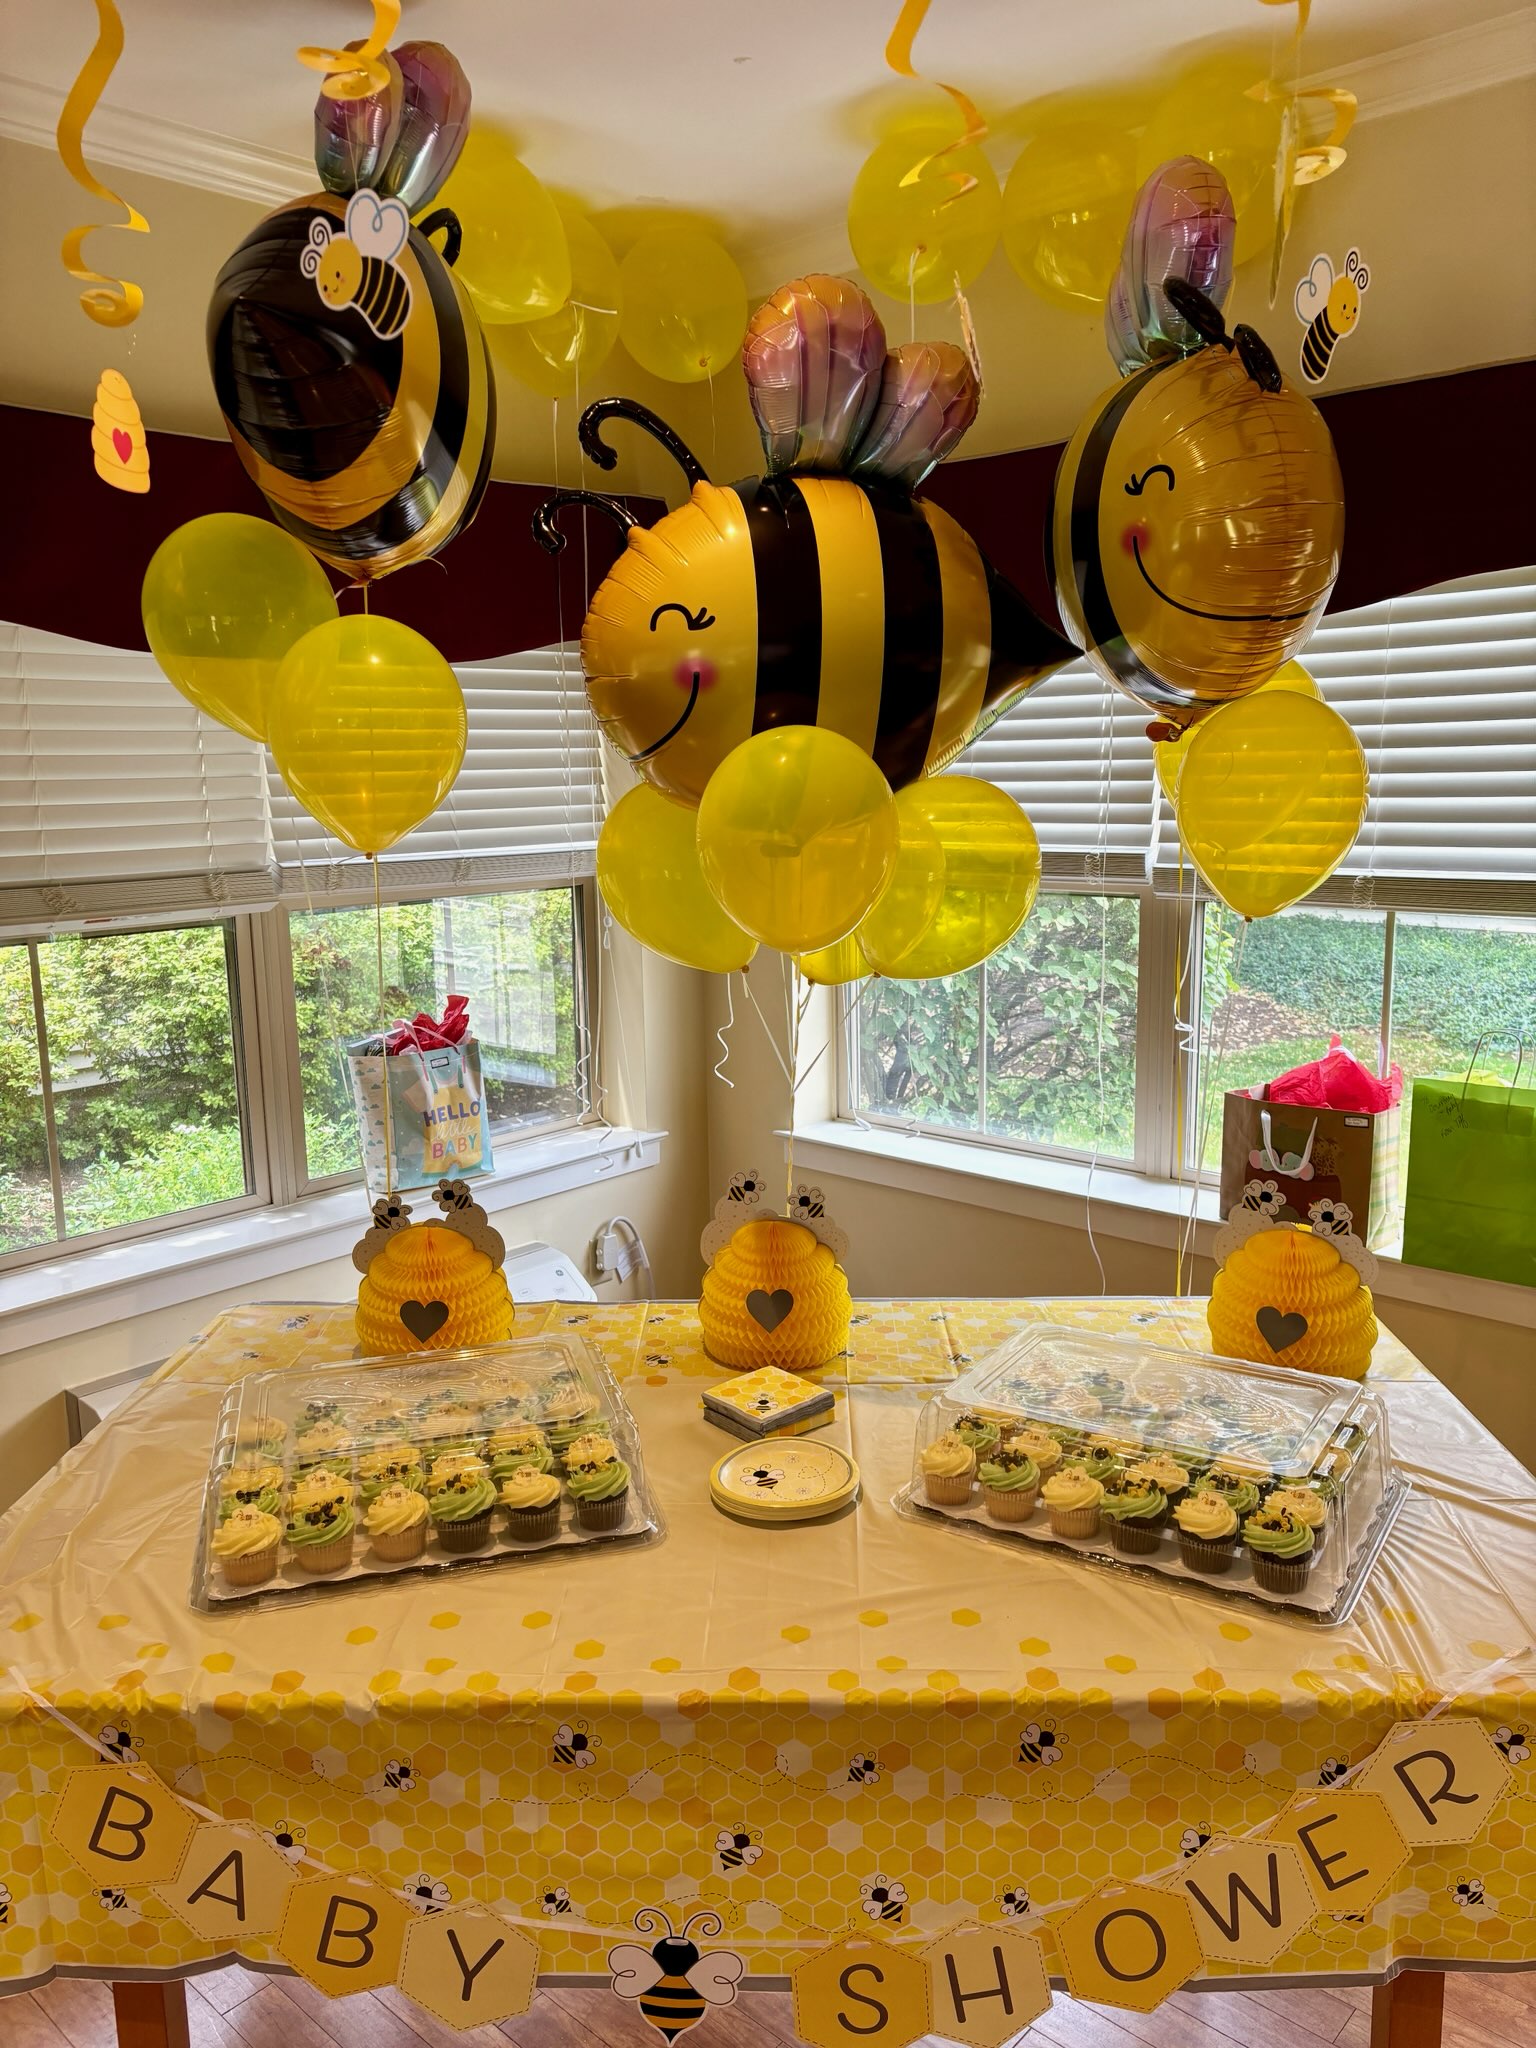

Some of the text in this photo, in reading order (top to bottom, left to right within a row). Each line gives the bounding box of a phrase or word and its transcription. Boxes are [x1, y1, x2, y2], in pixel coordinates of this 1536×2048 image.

[423, 1101, 481, 1127] HELLO
[432, 1133, 478, 1159] BABY
[88, 1749, 1481, 2035] BABY SHOWER
